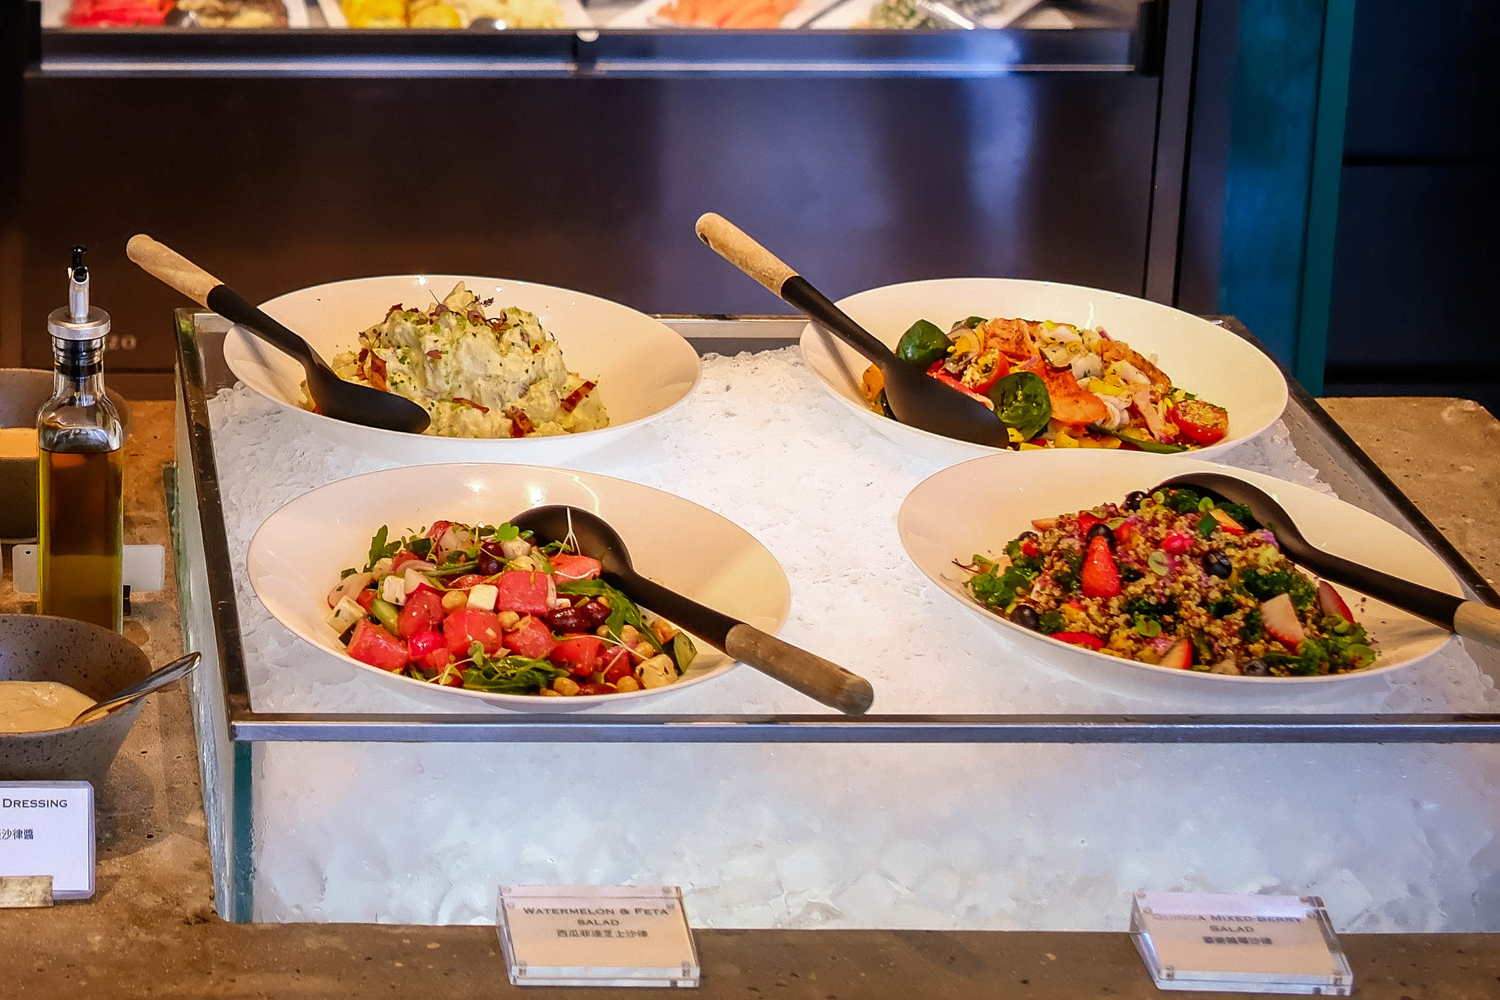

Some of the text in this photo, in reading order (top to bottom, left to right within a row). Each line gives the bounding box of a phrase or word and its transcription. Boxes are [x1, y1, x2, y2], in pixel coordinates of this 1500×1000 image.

[2, 798, 68, 809] DRESSING
[523, 907, 669, 916] WATERMELON & FETA
[577, 918, 620, 927] SALAD
[1209, 924, 1255, 933] SALAD
